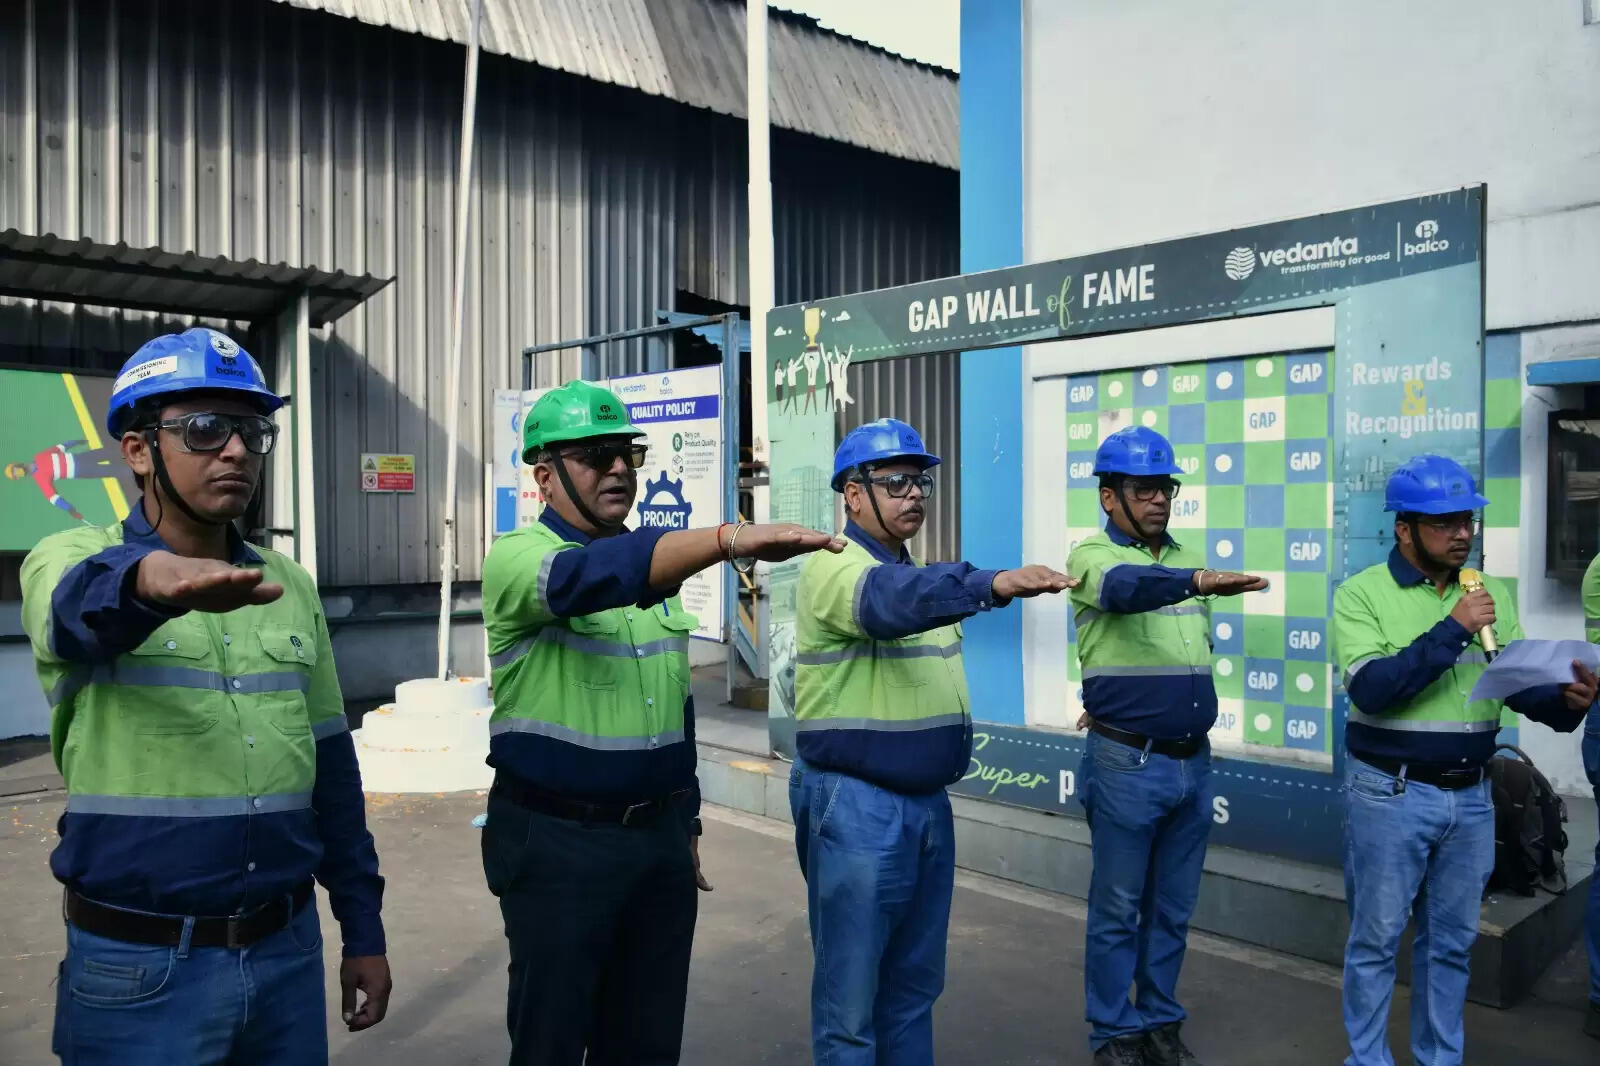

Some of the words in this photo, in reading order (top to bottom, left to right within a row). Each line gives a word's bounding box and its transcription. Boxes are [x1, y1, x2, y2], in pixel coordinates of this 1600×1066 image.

[1259, 235, 1358, 268] vedanta
[1404, 239, 1449, 256] balco
[1281, 258, 1346, 275] transforming
[1348, 256, 1363, 266] for
[1365, 252, 1390, 264] good
[908, 295, 958, 333] GAP
[966, 283, 1040, 325] WALL
[1047, 275, 1074, 330] of
[1082, 264, 1155, 309] FAME
[1290, 363, 1322, 384] GAP
[1352, 357, 1452, 385] Rewards
[1070, 384, 1094, 402] GAP
[1172, 375, 1200, 393] GAP
[1402, 380, 1427, 415] &
[631, 404, 663, 419] QUALITY
[666, 401, 696, 417] POLICY
[1250, 411, 1276, 429] GAP
[1346, 408, 1478, 439] Recognition
[1069, 423, 1092, 439] GAP
[1070, 462, 1093, 479] GAP
[1290, 452, 1321, 471] GAP
[1174, 500, 1199, 516] GAP
[643, 511, 686, 529] PROACT
[1290, 542, 1321, 561] GAP
[1289, 630, 1320, 649] GAP
[1248, 671, 1278, 690] GAP
[1287, 719, 1317, 738] GAP
